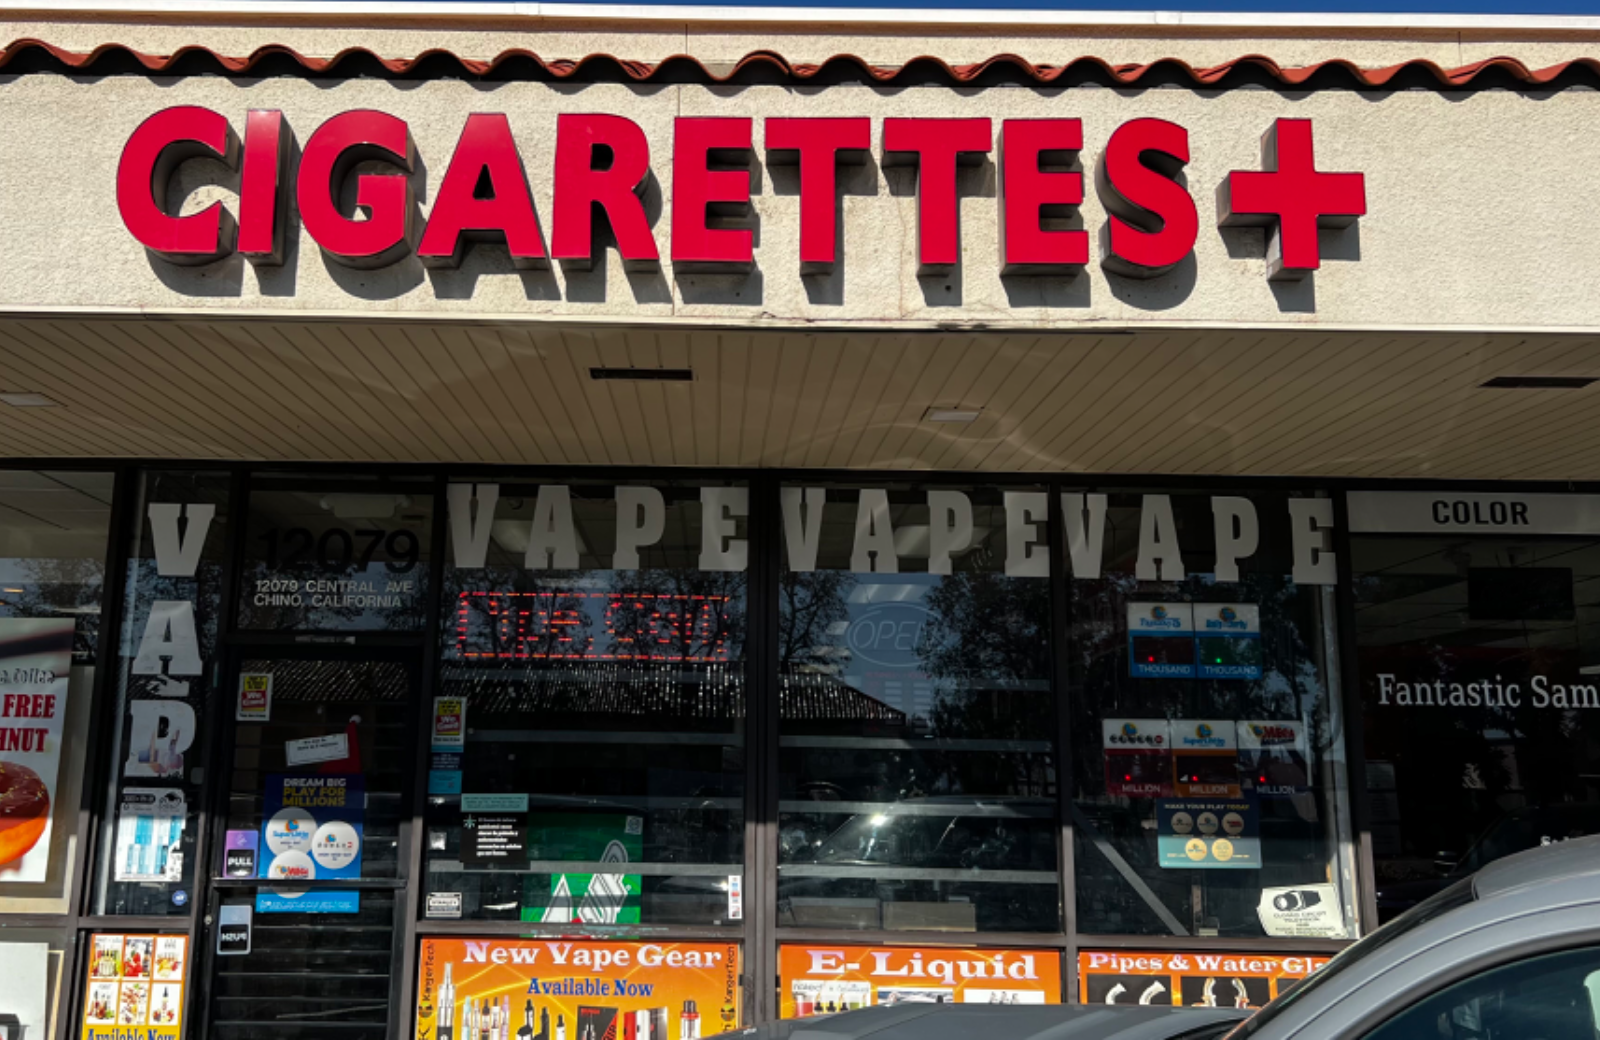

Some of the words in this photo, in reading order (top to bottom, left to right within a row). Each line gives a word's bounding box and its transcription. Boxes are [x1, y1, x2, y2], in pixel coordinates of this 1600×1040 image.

[1432, 500, 1530, 526] COLOR
[446, 483, 749, 571] VAPE
[780, 487, 1050, 577] VAPE
[1060, 492, 1337, 585] VAPE
[257, 526, 419, 574] 12079
[255, 579, 299, 593] 12079
[305, 579, 377, 593] CENTRAL
[385, 580, 413, 593] AVE
[254, 593, 304, 609] CHINO,
[312, 594, 402, 608] CALIFORNIA
[1138, 664, 1191, 675] THOUSAND
[1204, 665, 1257, 675] THOUSAND
[1377, 673, 1522, 707] Fantastic
[2, 694, 56, 718] FREE
[283, 778, 324, 787] DREAM
[327, 778, 346, 787] BIG
[1122, 784, 1161, 794] MILLION
[1189, 785, 1228, 794] MILLION
[1256, 785, 1296, 795] MILLION
[283, 787, 315, 796] PLAY
[319, 787, 346, 797] FOR
[282, 796, 346, 807] MILLIONS
[227, 855, 253, 866] PULL
[463, 941, 540, 964] New
[546, 942, 630, 971] Vape
[637, 944, 722, 968] Gear
[1088, 953, 1164, 974] Pipes
[1167, 954, 1190, 971] &
[1193, 955, 1278, 972] Water
[870, 951, 1039, 985] Liquid
[527, 978, 609, 997] Available
[613, 979, 654, 997] Now
